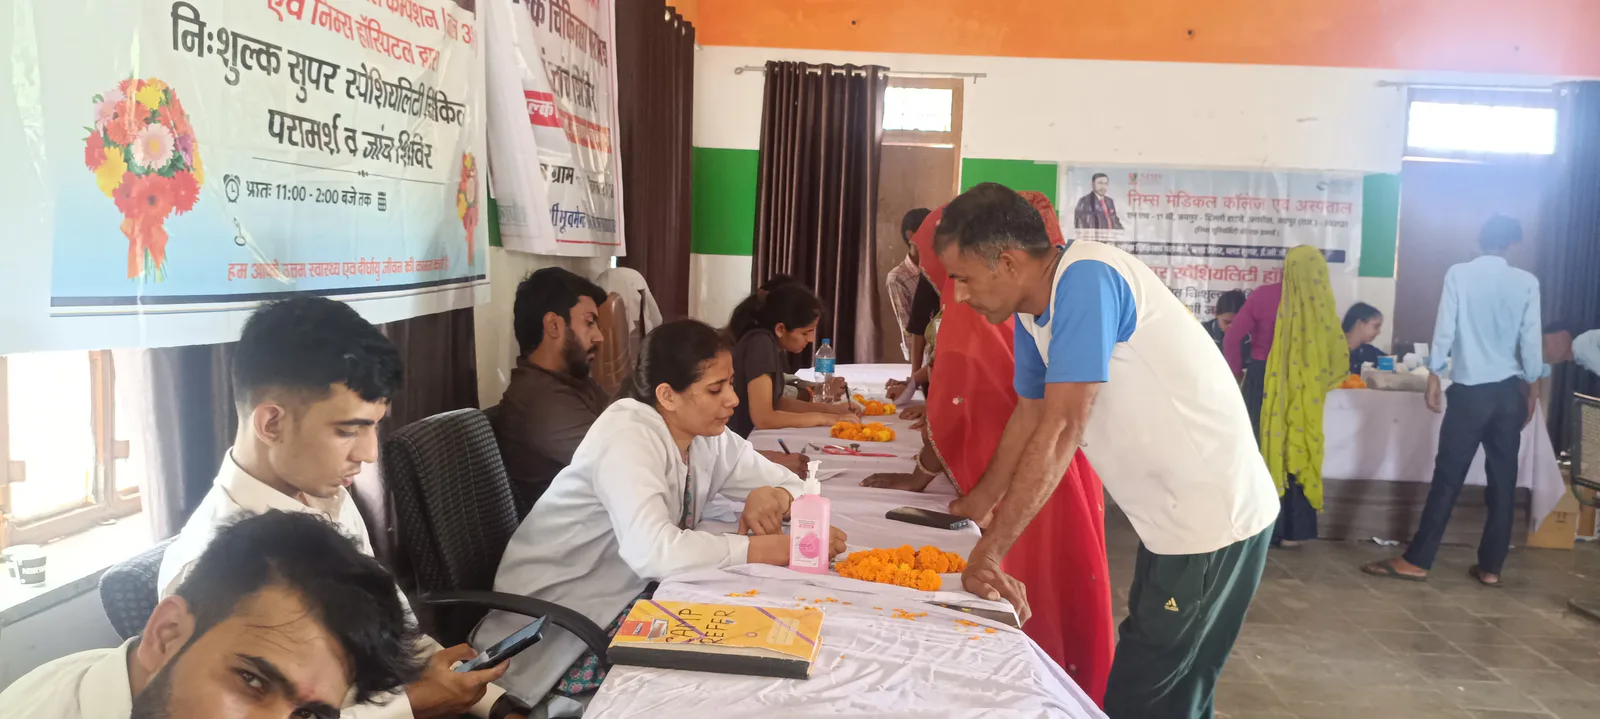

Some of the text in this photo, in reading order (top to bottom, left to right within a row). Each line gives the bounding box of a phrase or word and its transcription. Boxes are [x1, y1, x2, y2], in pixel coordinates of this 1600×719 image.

[287, 49, 341, 104] सुपर
[526, 100, 554, 117] ल्क
[267, 108, 342, 156] परामर्श
[343, 127, 359, 157] व
[361, 124, 395, 163] जांच
[551, 164, 575, 185] ग्राम
[275, 184, 306, 202] 11:00
[315, 188, 339, 204] 2:00
[340, 186, 358, 206] बजे
[358, 192, 373, 207] तक
[1165, 190, 1218, 209] मेडिकल
[1296, 199, 1353, 215] अस्पताल
[227, 263, 249, 281] हम
[405, 257, 414, 272] की
[1263, 267, 1284, 283] हॉ
